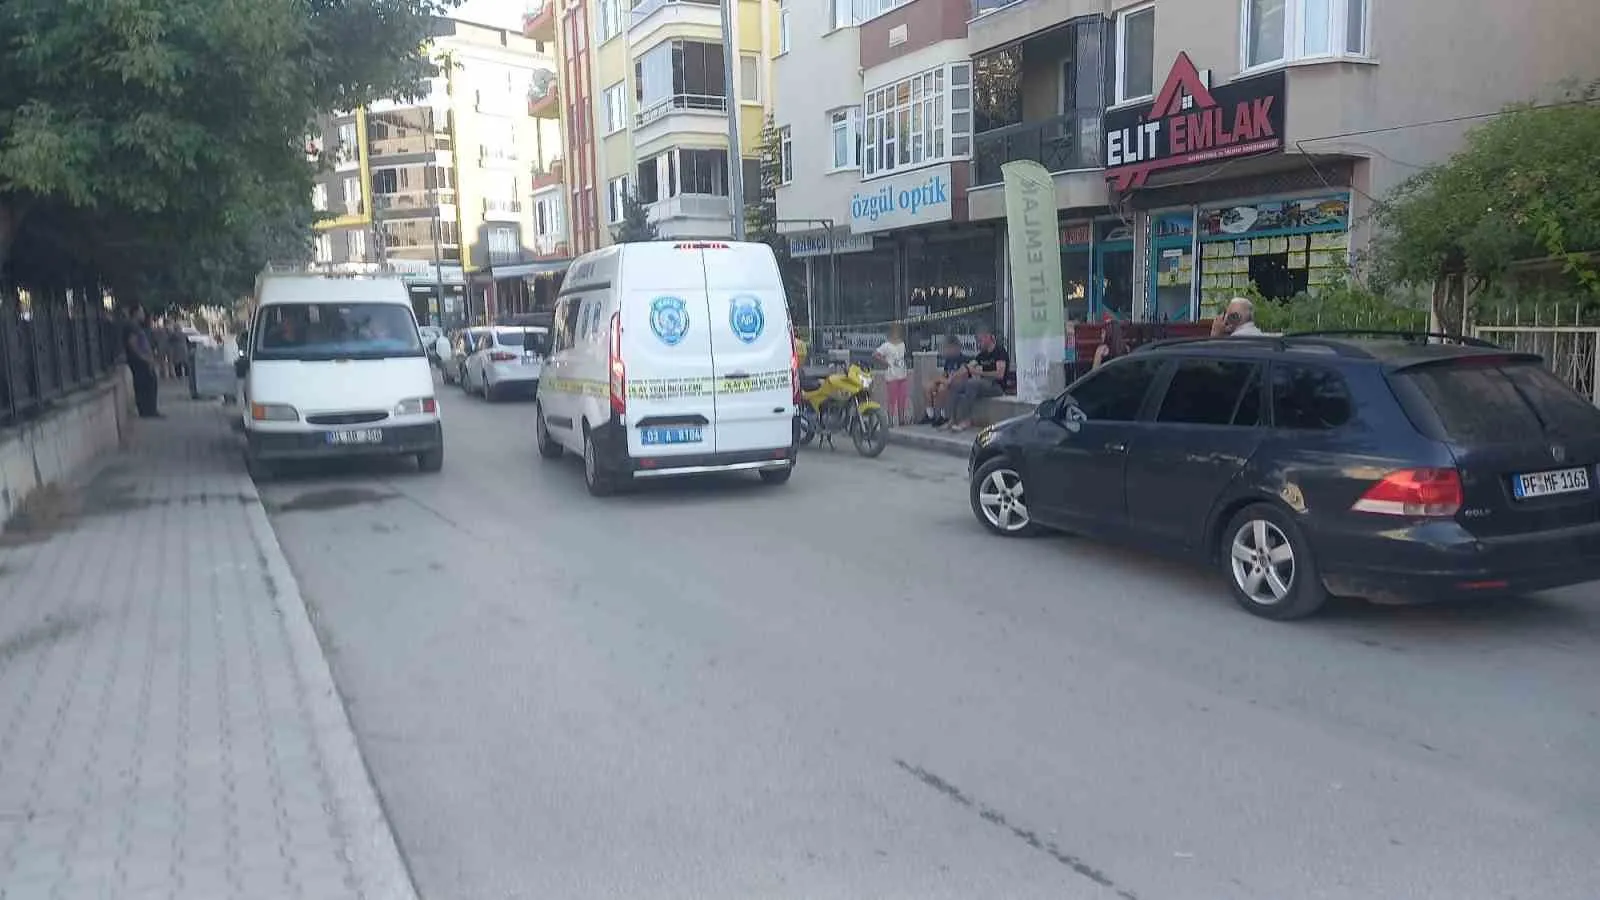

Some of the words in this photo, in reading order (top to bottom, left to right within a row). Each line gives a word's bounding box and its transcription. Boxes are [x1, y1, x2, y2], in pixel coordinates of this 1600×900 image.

[1170, 95, 1275, 154] EMLAK
[852, 184, 895, 222] özgül
[899, 175, 946, 214] optik
[1521, 476, 1537, 494] PF
[1544, 473, 1558, 492] MF
[1560, 470, 1587, 490] 1163
